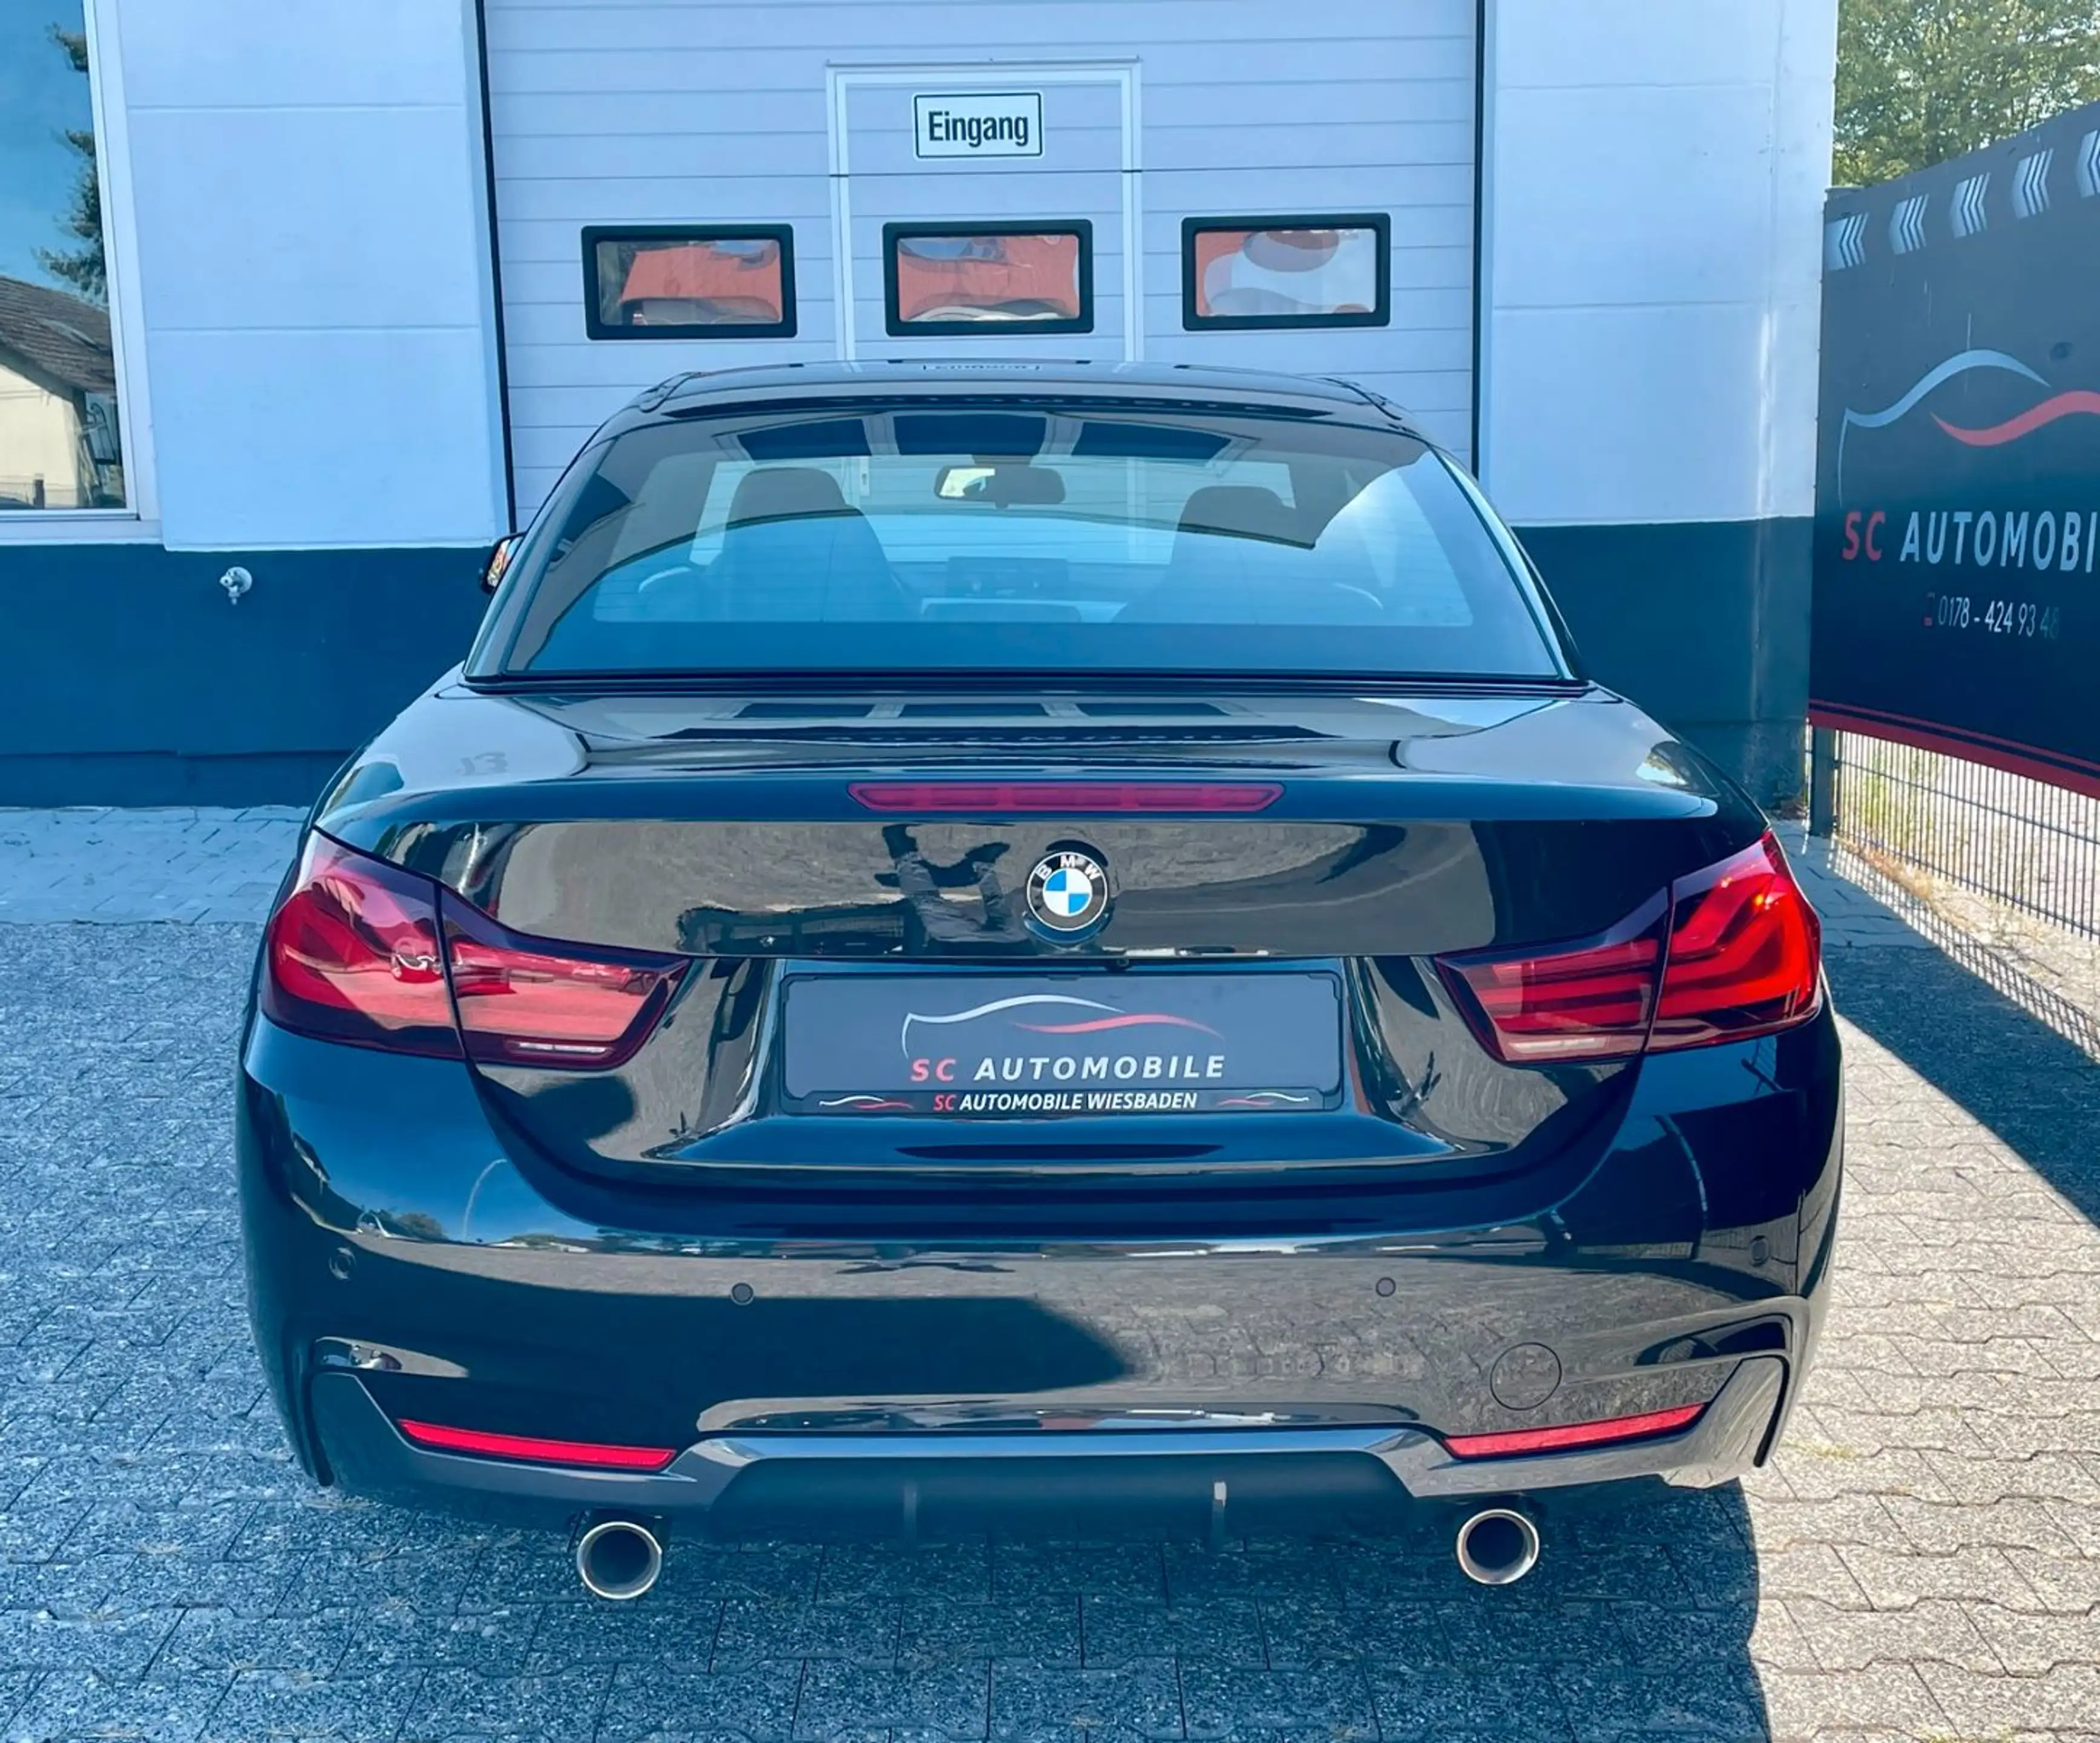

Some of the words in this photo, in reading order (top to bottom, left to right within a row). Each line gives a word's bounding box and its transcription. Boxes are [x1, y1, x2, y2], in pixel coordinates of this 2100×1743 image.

[928, 111, 1029, 148] Eingang
[1842, 511, 1886, 560] SC
[1899, 510, 2098, 573] AUTOMOBI
[1938, 596, 1970, 629] 0178
[1984, 600, 2015, 633] 424
[2018, 603, 2036, 637] 93
[1035, 855, 1101, 880] BMW
[910, 1058, 957, 1082] SC
[973, 1055, 1226, 1081] AUTOMOBILE
[933, 1094, 957, 1111] SC
[959, 1093, 1084, 1111] AUTOMOBILE
[1088, 1091, 1198, 1110] WIESBADEN
